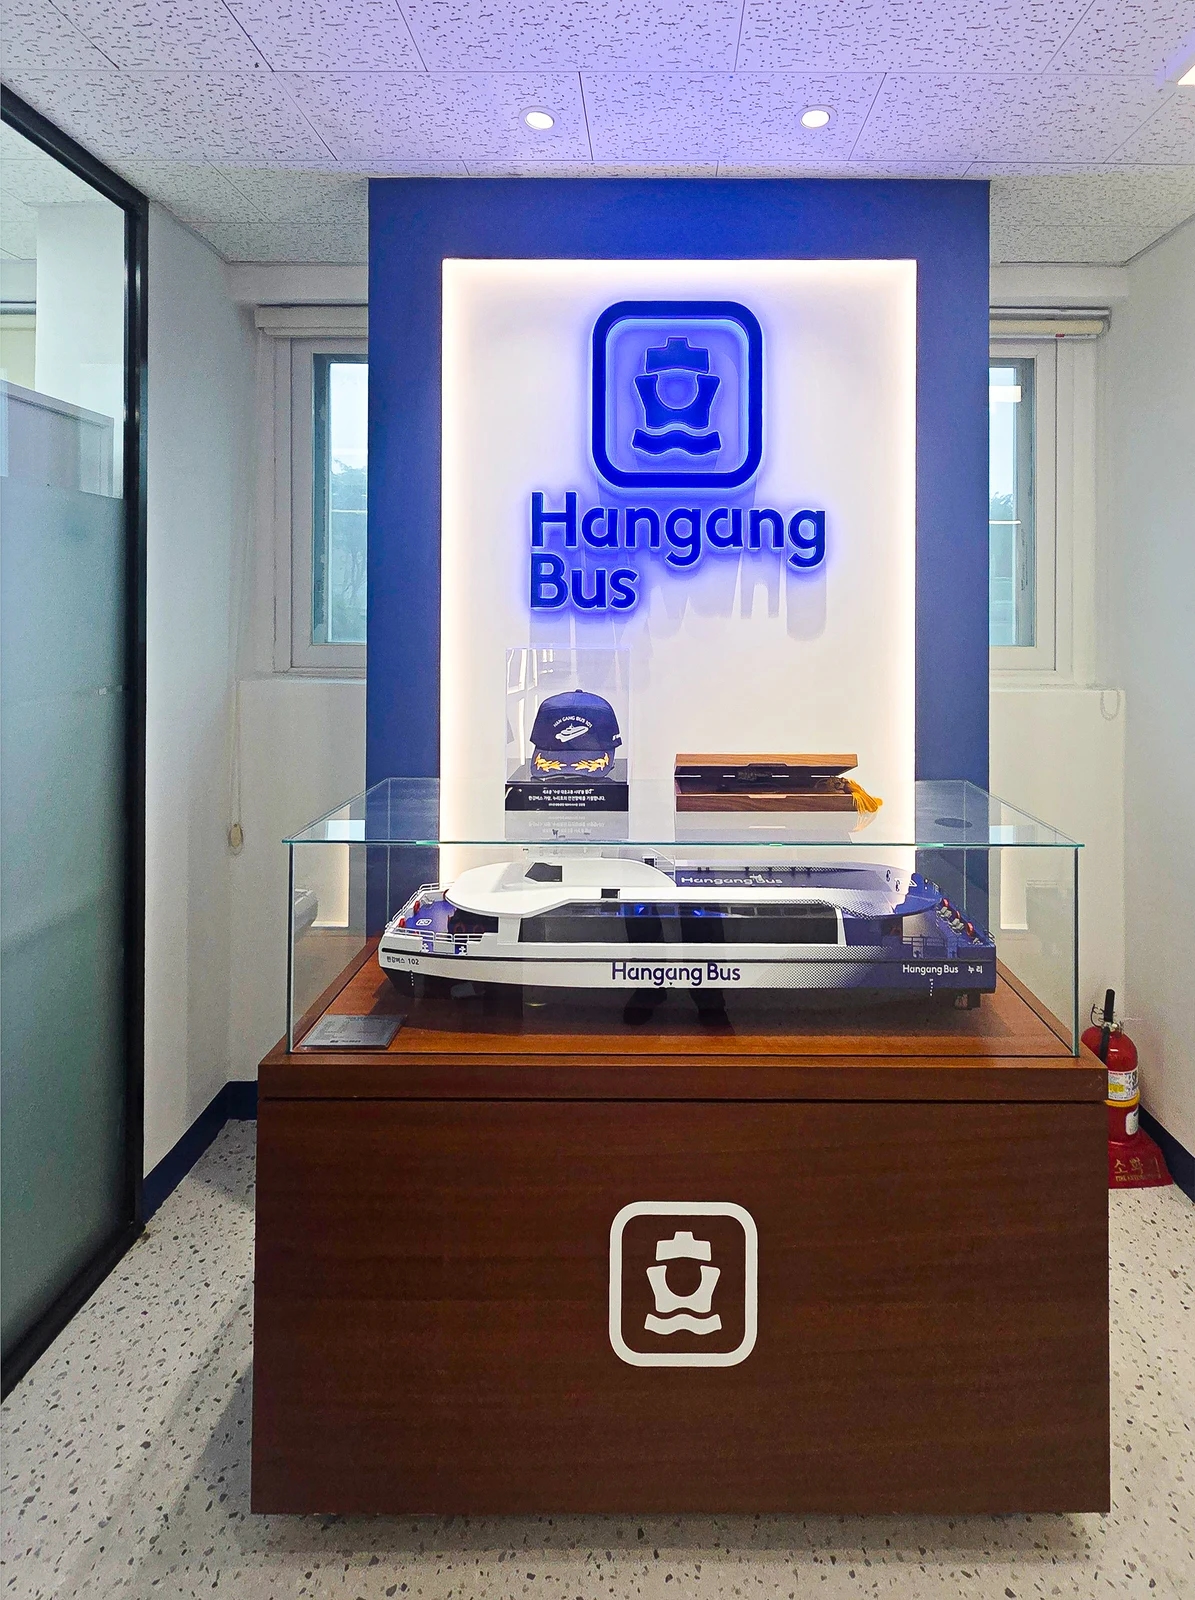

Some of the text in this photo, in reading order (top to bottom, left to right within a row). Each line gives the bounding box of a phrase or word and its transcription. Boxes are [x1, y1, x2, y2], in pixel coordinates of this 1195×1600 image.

[531, 491, 826, 567] Hangang
[530, 552, 638, 609] Bus
[681, 877, 753, 885] Hangang
[386, 955, 419, 965] 한강버스 102
[611, 961, 741, 986] Hangang Bus
[902, 964, 959, 976] Hangang Bus
